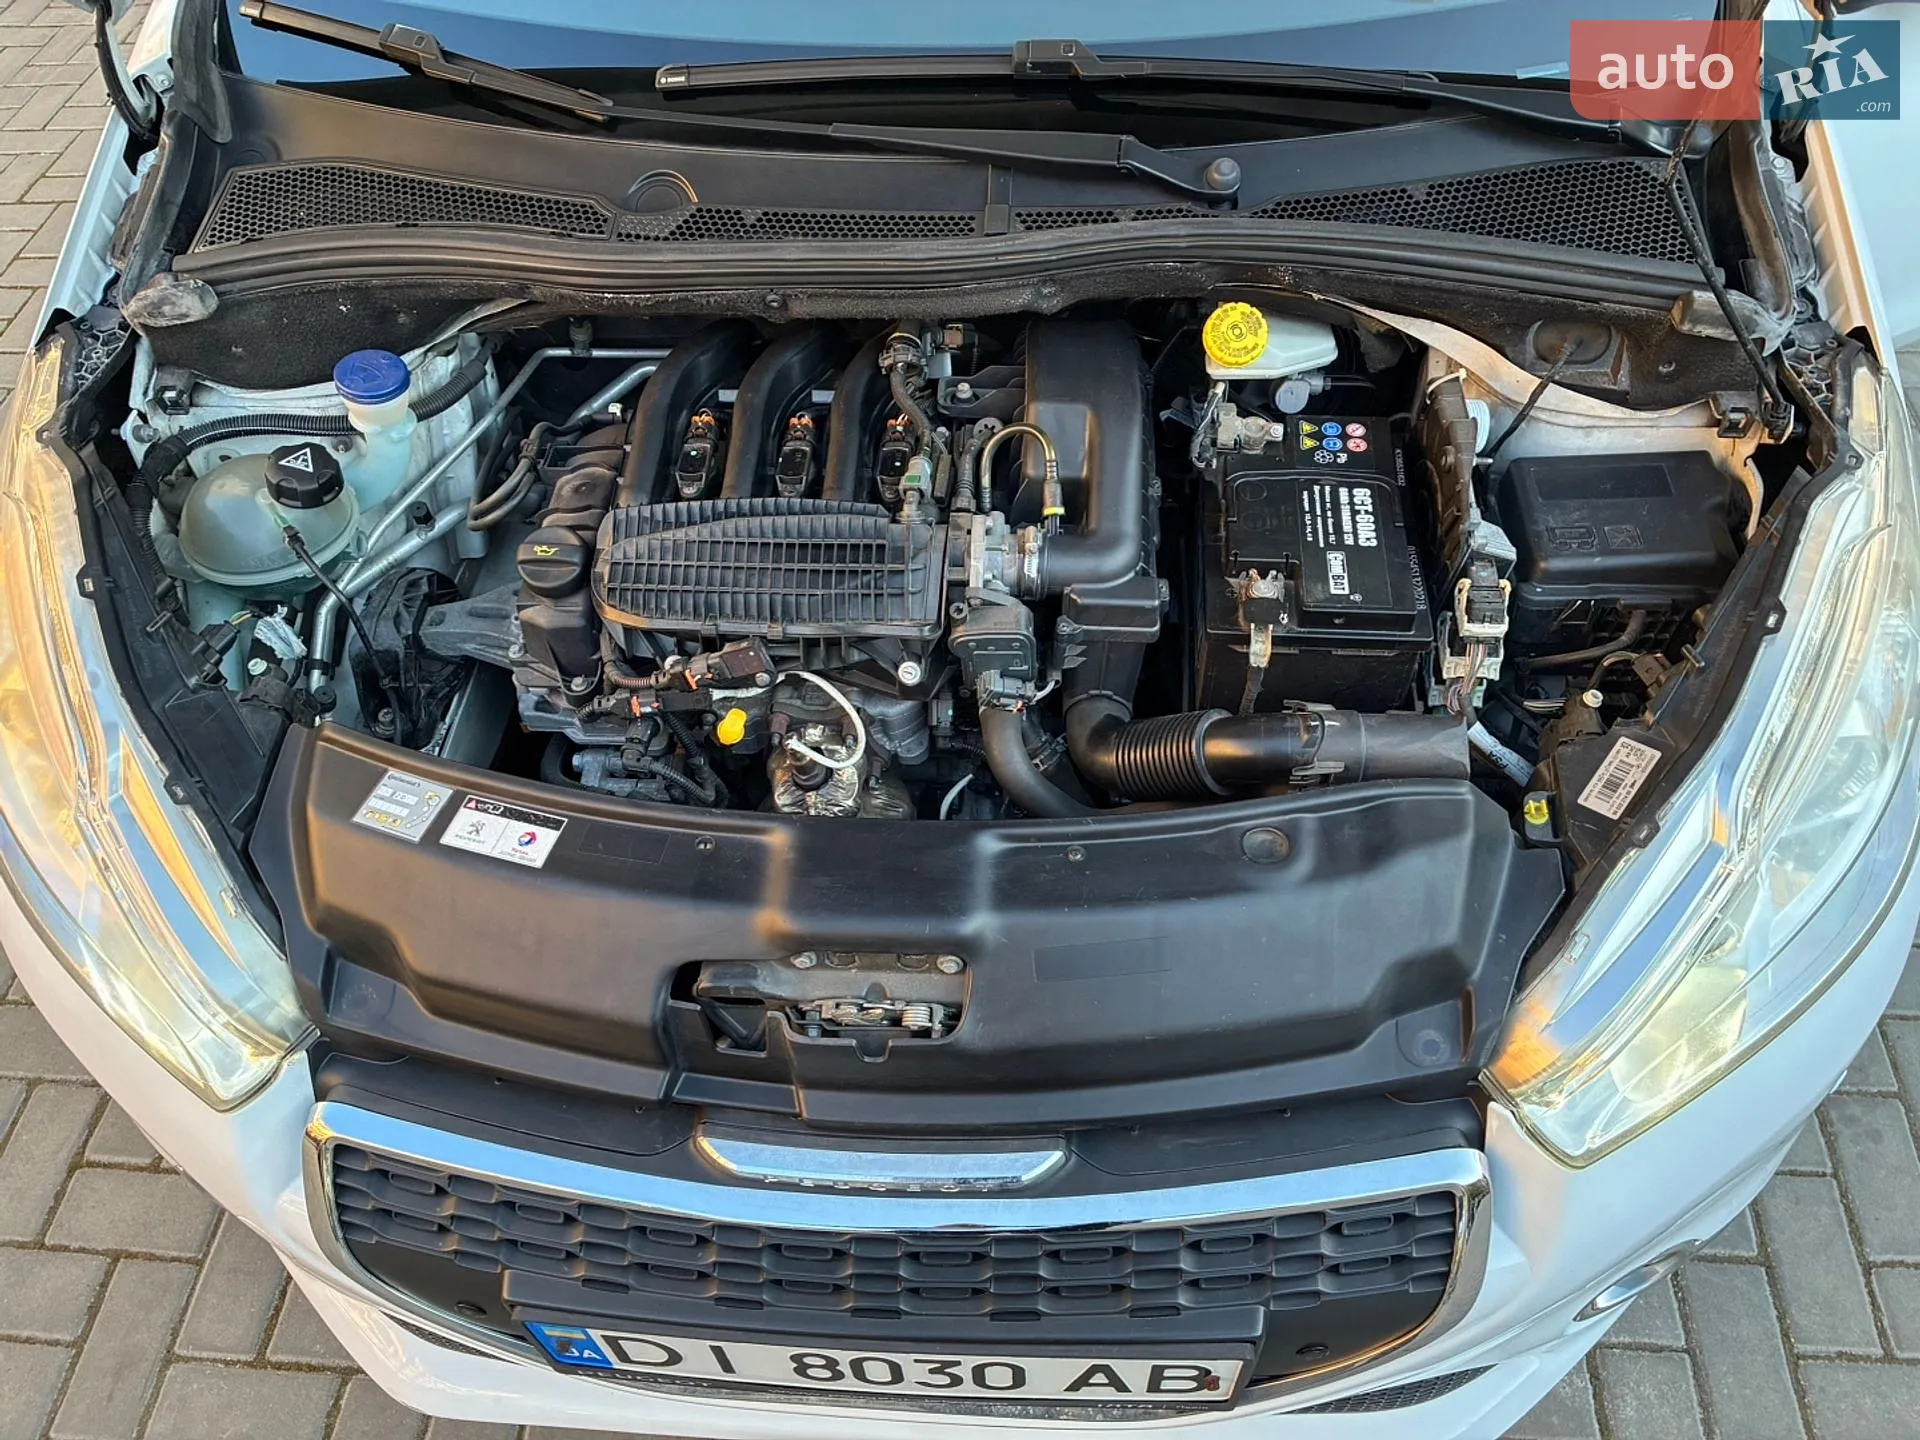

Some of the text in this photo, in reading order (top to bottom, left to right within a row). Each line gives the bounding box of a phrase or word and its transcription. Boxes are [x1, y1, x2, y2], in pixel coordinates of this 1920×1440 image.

[1336, 453, 1348, 463] Pb
[600, 1334, 1213, 1394] DI 8030 AB
